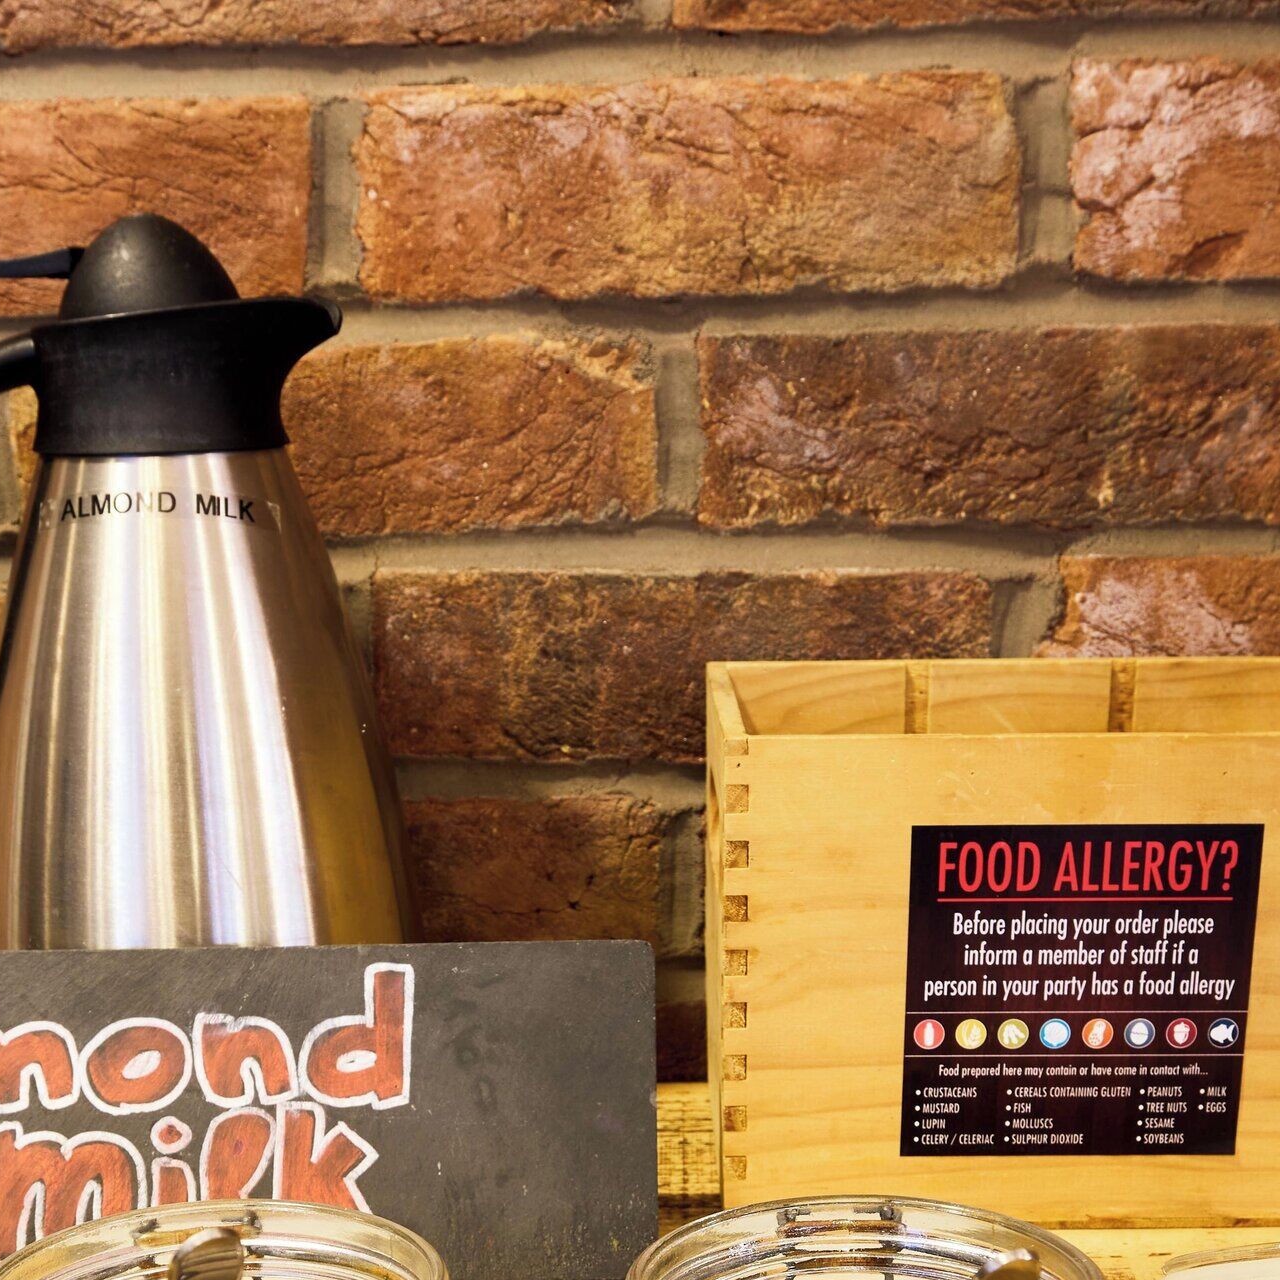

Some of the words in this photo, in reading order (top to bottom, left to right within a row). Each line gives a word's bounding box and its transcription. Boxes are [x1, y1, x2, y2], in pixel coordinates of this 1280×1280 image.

[61, 491, 176, 521] ALMOND
[196, 494, 255, 523] MILK
[937, 840, 1041, 892] FOOD
[1053, 839, 1239, 892] ALLERGY?
[953, 910, 1006, 935] Before
[1011, 912, 1068, 940] placing
[1073, 915, 1110, 940] your
[1115, 909, 1158, 934] order
[1163, 909, 1214, 939] please
[964, 941, 1017, 966] inform
[1022, 949, 1033, 966] a
[1038, 940, 1105, 966] member
[1109, 940, 1127, 965] of
[1131, 940, 1168, 965] staff
[1172, 940, 1185, 964] if
[1188, 947, 1199, 964] a
[924, 976, 977, 1002] person
[982, 974, 997, 996] in
[1002, 976, 1039, 1001] your
[1043, 975, 1086, 1001] party
[1092, 971, 1119, 995] has
[1123, 978, 1134, 995] a
[1139, 971, 1174, 995] food
[1179, 971, 1235, 1000] allergy
[939, 1063, 960, 1077] Food
[961, 1063, 1001, 1079] prepared
[1003, 1063, 1023, 1076] here
[1024, 1066, 1044, 1078] may
[1046, 1064, 1077, 1076] contain
[1079, 1066, 1089, 1076] or
[1091, 1063, 1112, 1076] have
[1114, 1065, 1137, 1075] come
[1139, 1064, 1148, 1075] in
[1150, 1064, 1180, 1075] contact
[1182, 1063, 1209, 1076] with...
[923, 1087, 977, 1098] CRUSTACEANS
[1014, 1087, 1047, 1098] CEREALS
[1049, 1086, 1098, 1098] CONTAINING
[1101, 1086, 1131, 1097] GLUTEN
[1147, 1086, 1182, 1097] PEANUTS
[1206, 1086, 1227, 1097] MILK
[922, 1103, 960, 1114] MUSTARD
[1013, 1103, 1031, 1113] FISH
[1146, 1102, 1164, 1113] TREE
[1167, 1102, 1188, 1113] NUTS
[1206, 1102, 1227, 1113] EGGS
[922, 1118, 946, 1129] LUPIN
[1012, 1118, 1053, 1129] MOLLUSCS
[1145, 1118, 1175, 1128] SESAME
[921, 1134, 949, 1145] CELERY
[950, 1133, 957, 1145] /
[959, 1134, 995, 1145] CELERIAC
[1011, 1134, 1048, 1145] SULPHUR
[1050, 1134, 1084, 1145] DIOXIDE
[1143, 1133, 1184, 1144] SOYBEANS
